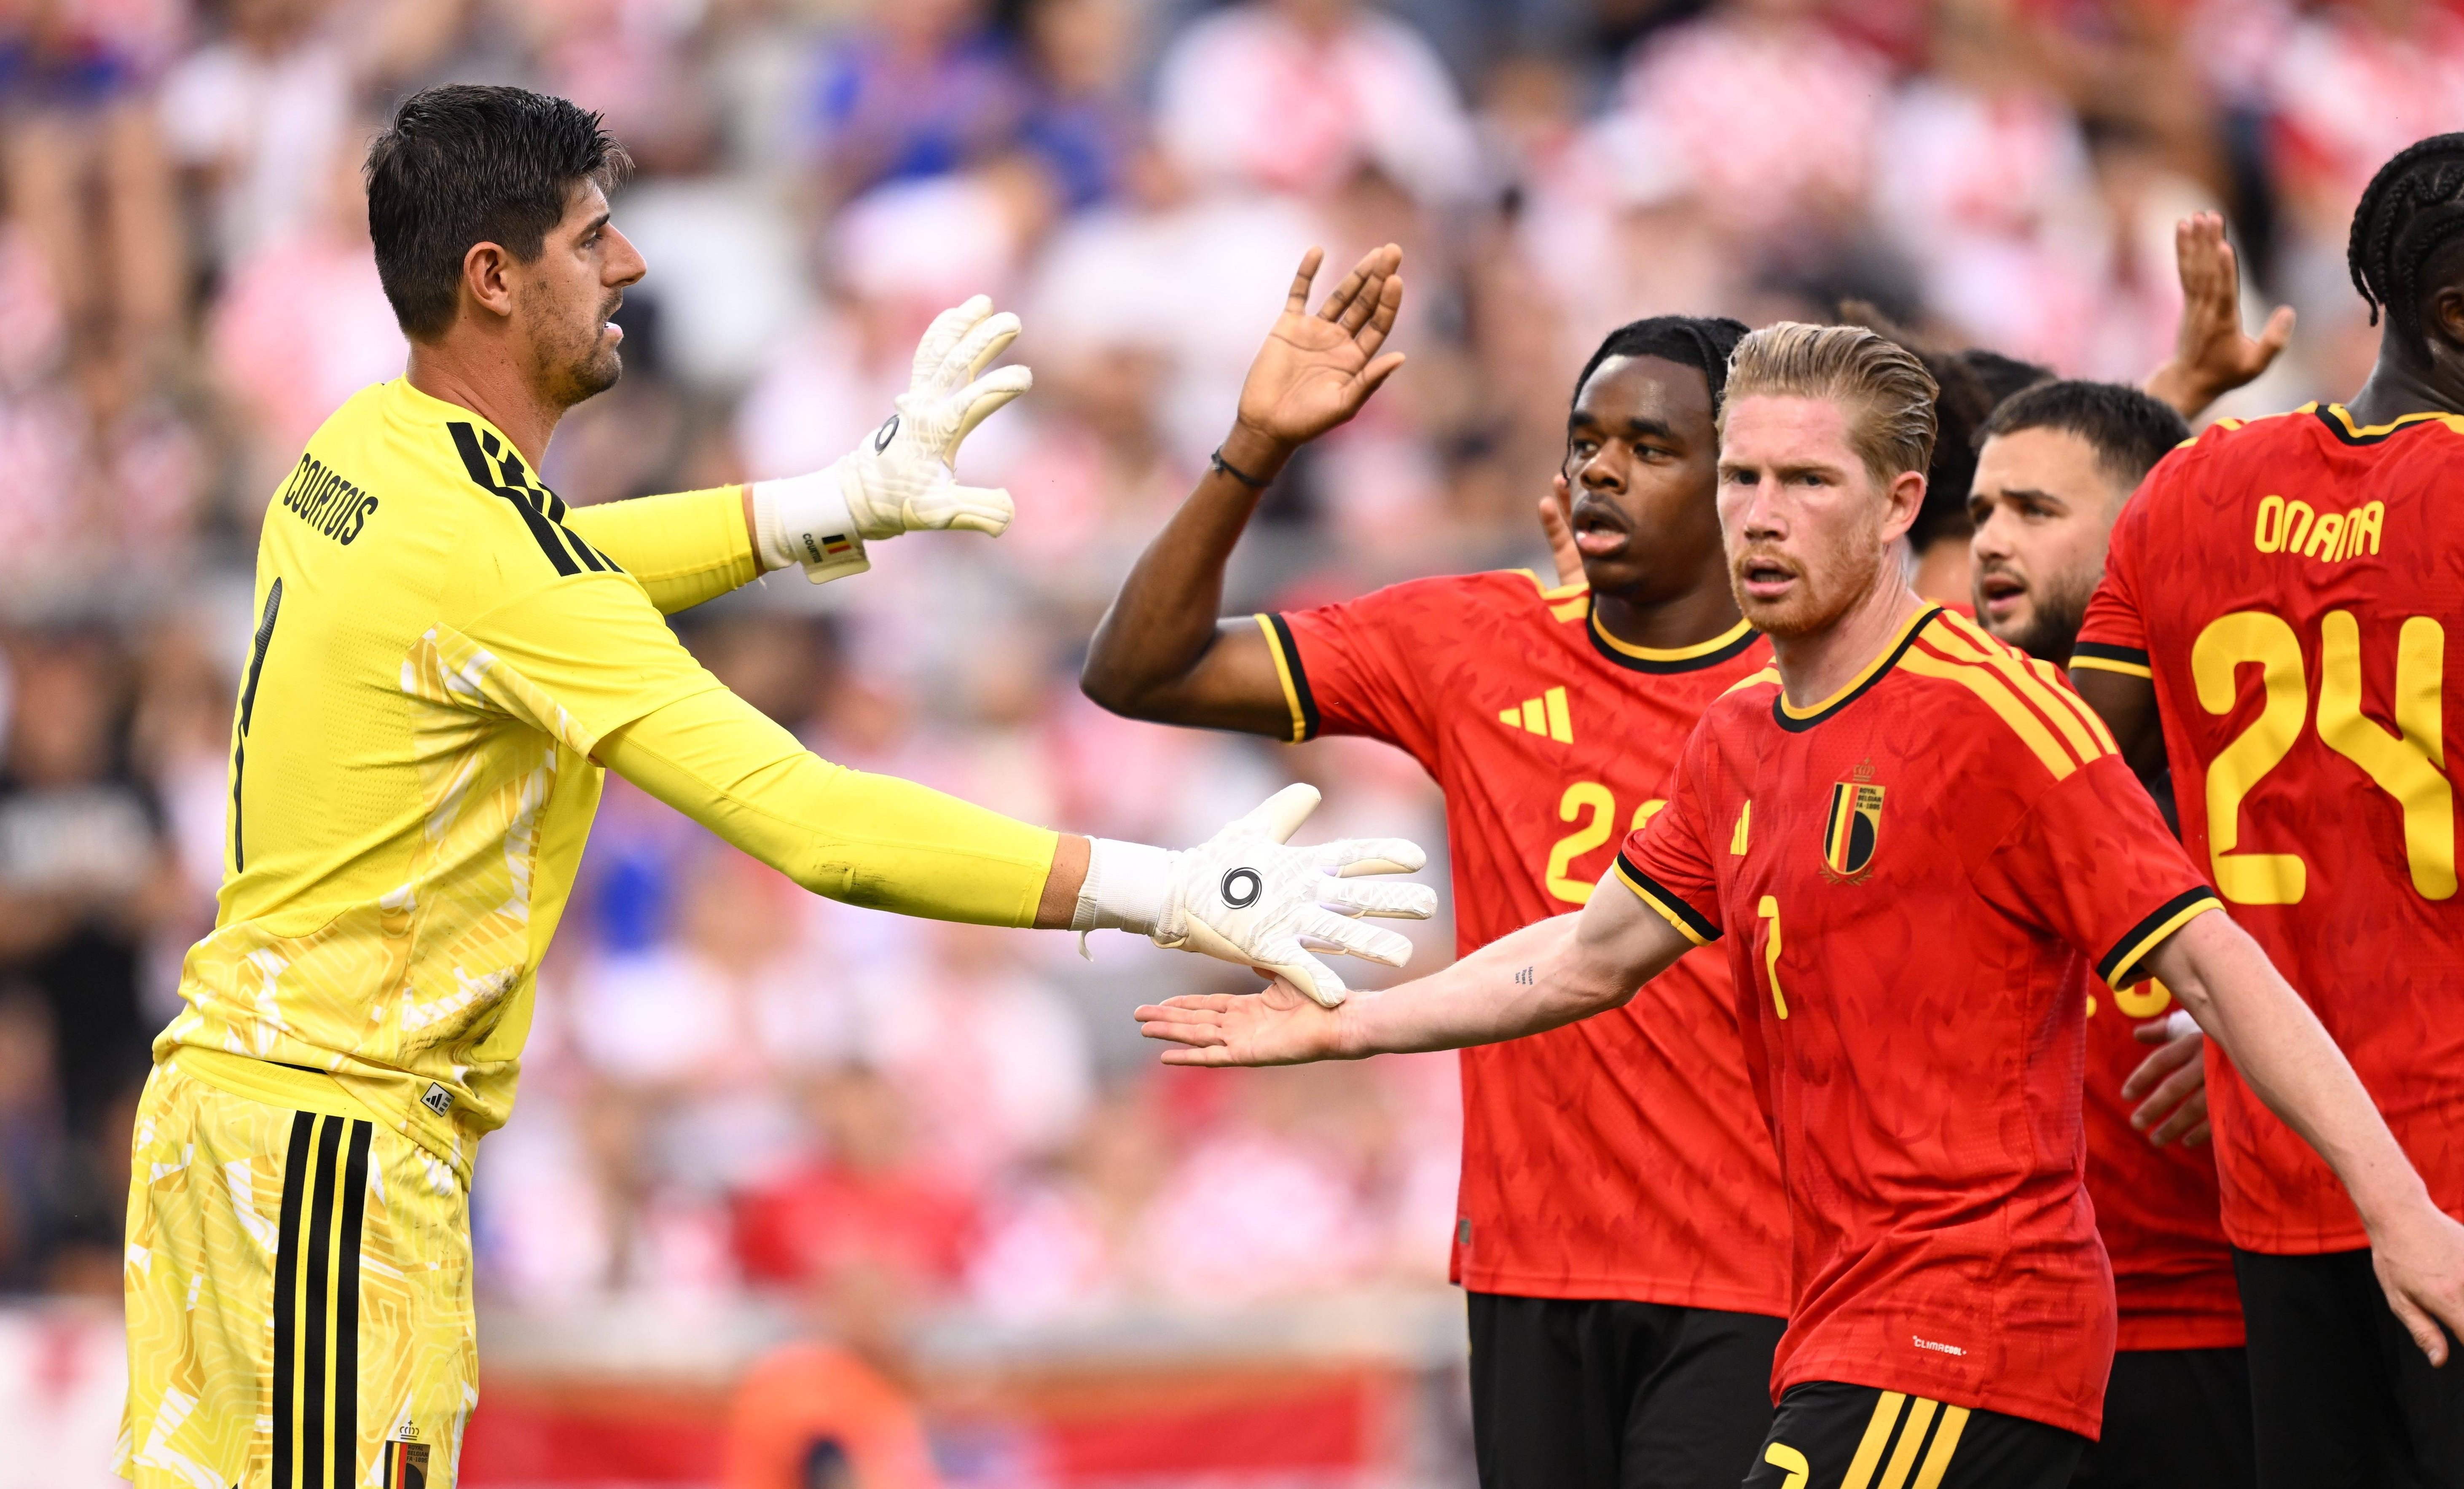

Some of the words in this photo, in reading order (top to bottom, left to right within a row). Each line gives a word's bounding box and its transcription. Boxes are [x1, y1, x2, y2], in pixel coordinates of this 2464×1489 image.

[283, 453, 378, 546] COURTOIS
[2255, 495, 2384, 562] ONANA
[2192, 609, 2458, 905] 24
[1545, 781, 1669, 904] 2
[1758, 895, 1788, 1020] 7
